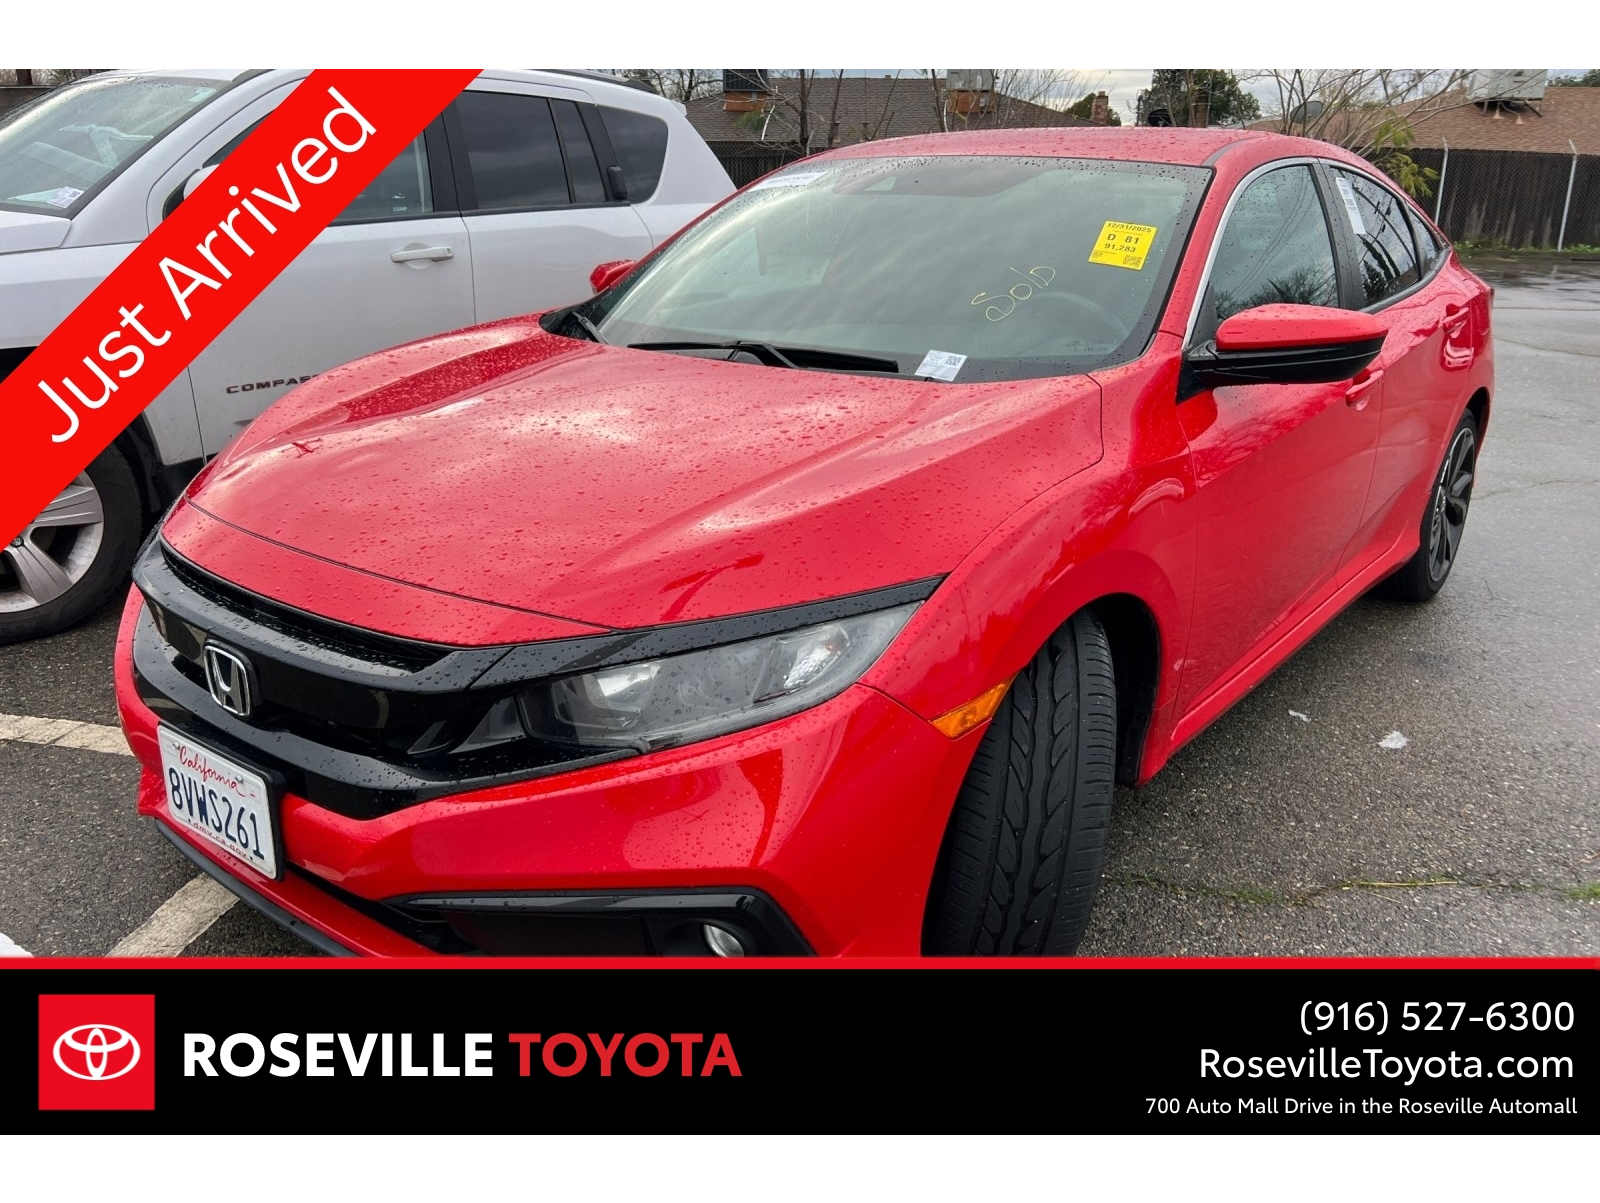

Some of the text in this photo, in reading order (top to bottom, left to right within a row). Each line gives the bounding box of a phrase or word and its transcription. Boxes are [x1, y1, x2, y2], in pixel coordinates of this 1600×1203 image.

[1125, 235, 1140, 244] 81
[226, 373, 320, 394] COMPAS
[178, 743, 248, 798] California
[168, 766, 265, 860] 8VWS261
